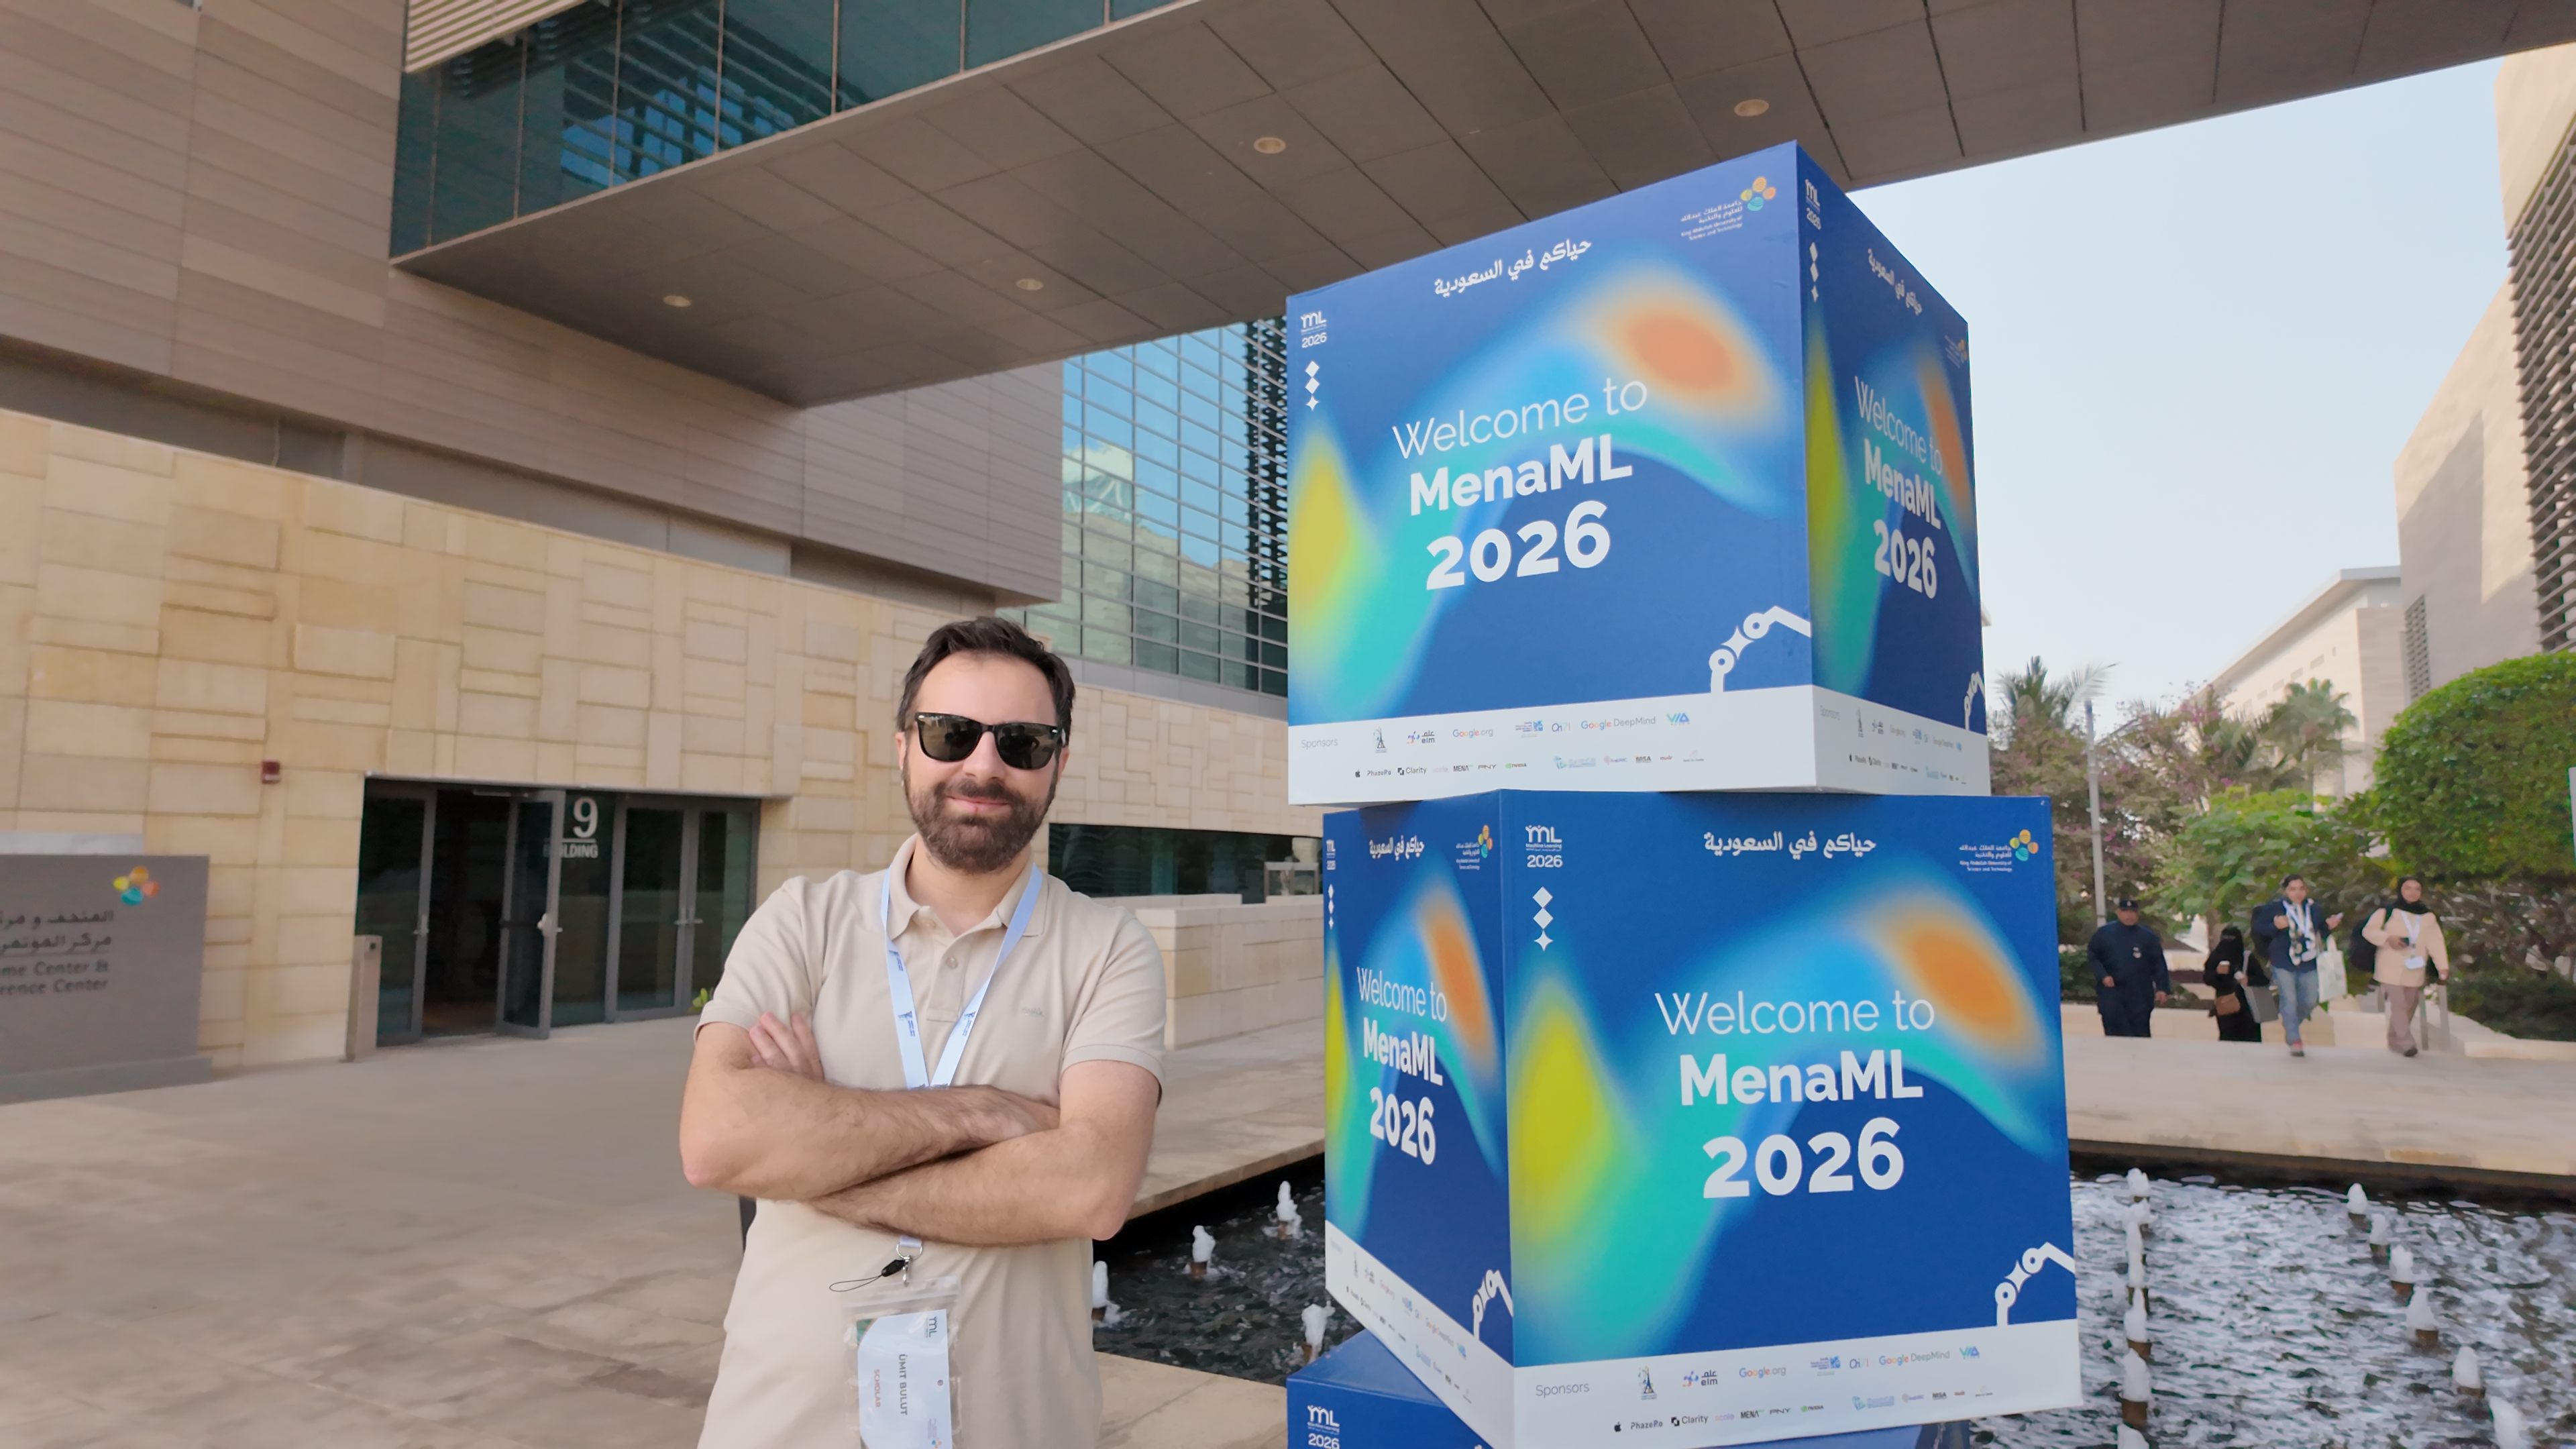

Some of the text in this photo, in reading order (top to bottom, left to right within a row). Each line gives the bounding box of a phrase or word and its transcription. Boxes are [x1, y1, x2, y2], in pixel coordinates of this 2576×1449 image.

[1434, 239, 1591, 297] حياكم في السعودية
[1301, 331, 1328, 348] 2026
[1392, 377, 1648, 459] Welcome to
[1854, 376, 1943, 475] Welcome to
[1410, 433, 1633, 516] MenaML
[1864, 437, 1941, 530] MenaML
[1426, 500, 1611, 590] 2026
[1873, 519, 1937, 599] 2026
[1452, 728, 1494, 739] Google.org
[1580, 716, 1656, 731] Google DeepMind
[1301, 739, 1338, 750] Sponsors
[1405, 766, 1428, 775] Clarity
[572, 796, 598, 838] 9
[1703, 830, 1876, 860] حياكم في السعودية
[1526, 854, 1564, 868] 2026
[34, 961, 90, 976] Center
[53, 977, 109, 993] Center
[1356, 966, 1447, 1022] Welcome to
[1654, 990, 1935, 1035] Welcome to
[1363, 1017, 1443, 1086] MenaML
[1680, 1049, 1923, 1106] MenaML
[1370, 1087, 1436, 1165] 2026
[1703, 1116, 1904, 1199] 2026
[1739, 1366, 1786, 1379] Google.org
[1879, 1350, 1951, 1366] Google DeepMind
[1536, 1383, 1590, 1399] Sponsors
[1701, 1378, 1718, 1386] elm
[899, 1382, 908, 1415] BULUT
[1681, 1415, 1709, 1424] Clarity
[1307, 1432, 1340, 1449] 2026
